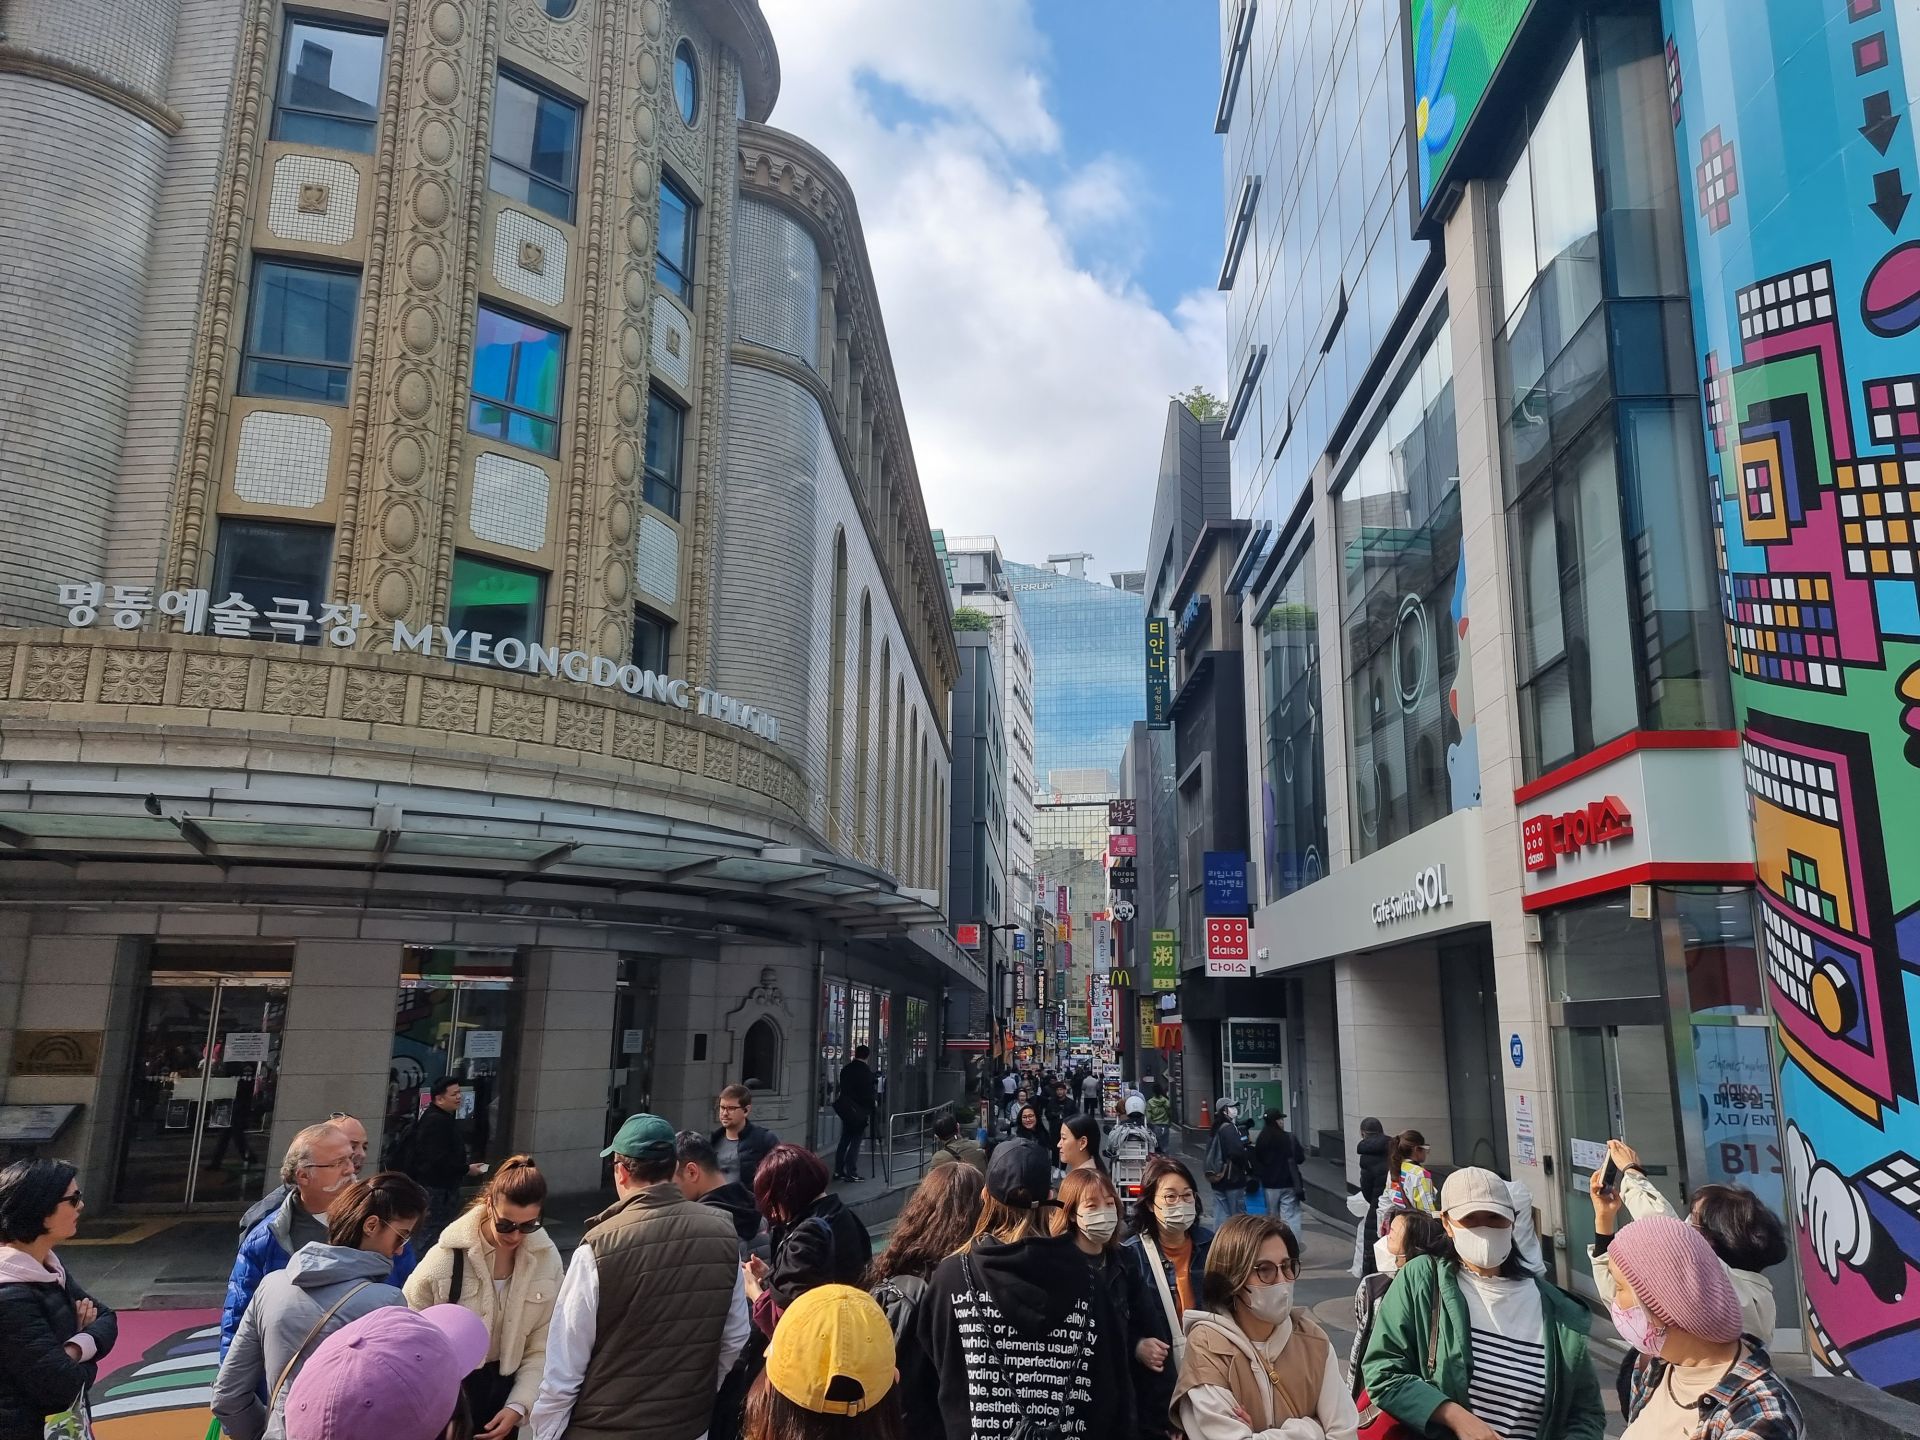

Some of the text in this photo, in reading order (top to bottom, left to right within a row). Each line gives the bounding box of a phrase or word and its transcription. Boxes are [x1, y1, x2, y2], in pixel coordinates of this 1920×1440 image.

[58, 582, 367, 647] 명동예술극장
[1149, 621, 1165, 672] 티안나
[392, 620, 690, 709] MYEONGDONG
[1110, 800, 1135, 811] 강남
[1111, 810, 1136, 824] 면옥
[1551, 795, 1633, 854] 다이소
[1527, 852, 1544, 865] daiso
[1208, 879, 1243, 888] 치과병원
[1416, 863, 1450, 911] SOL
[1221, 889, 1232, 897] 7F
[1153, 945, 1174, 967] 粥
[1212, 945, 1243, 955] daiso
[1211, 963, 1247, 972] 다이소
[1715, 1113, 1740, 1126] 入口
[1720, 1142, 1760, 1174] B1
[951, 1290, 973, 1305] Lo-fi
[993, 1324, 1007, 1334] or
[995, 1338, 1045, 1352] elements
[1075, 1375, 1092, 1387] are
[1051, 1391, 1064, 1401] as
[1026, 1402, 1060, 1416] choice
[1002, 1417, 1014, 1429] of
